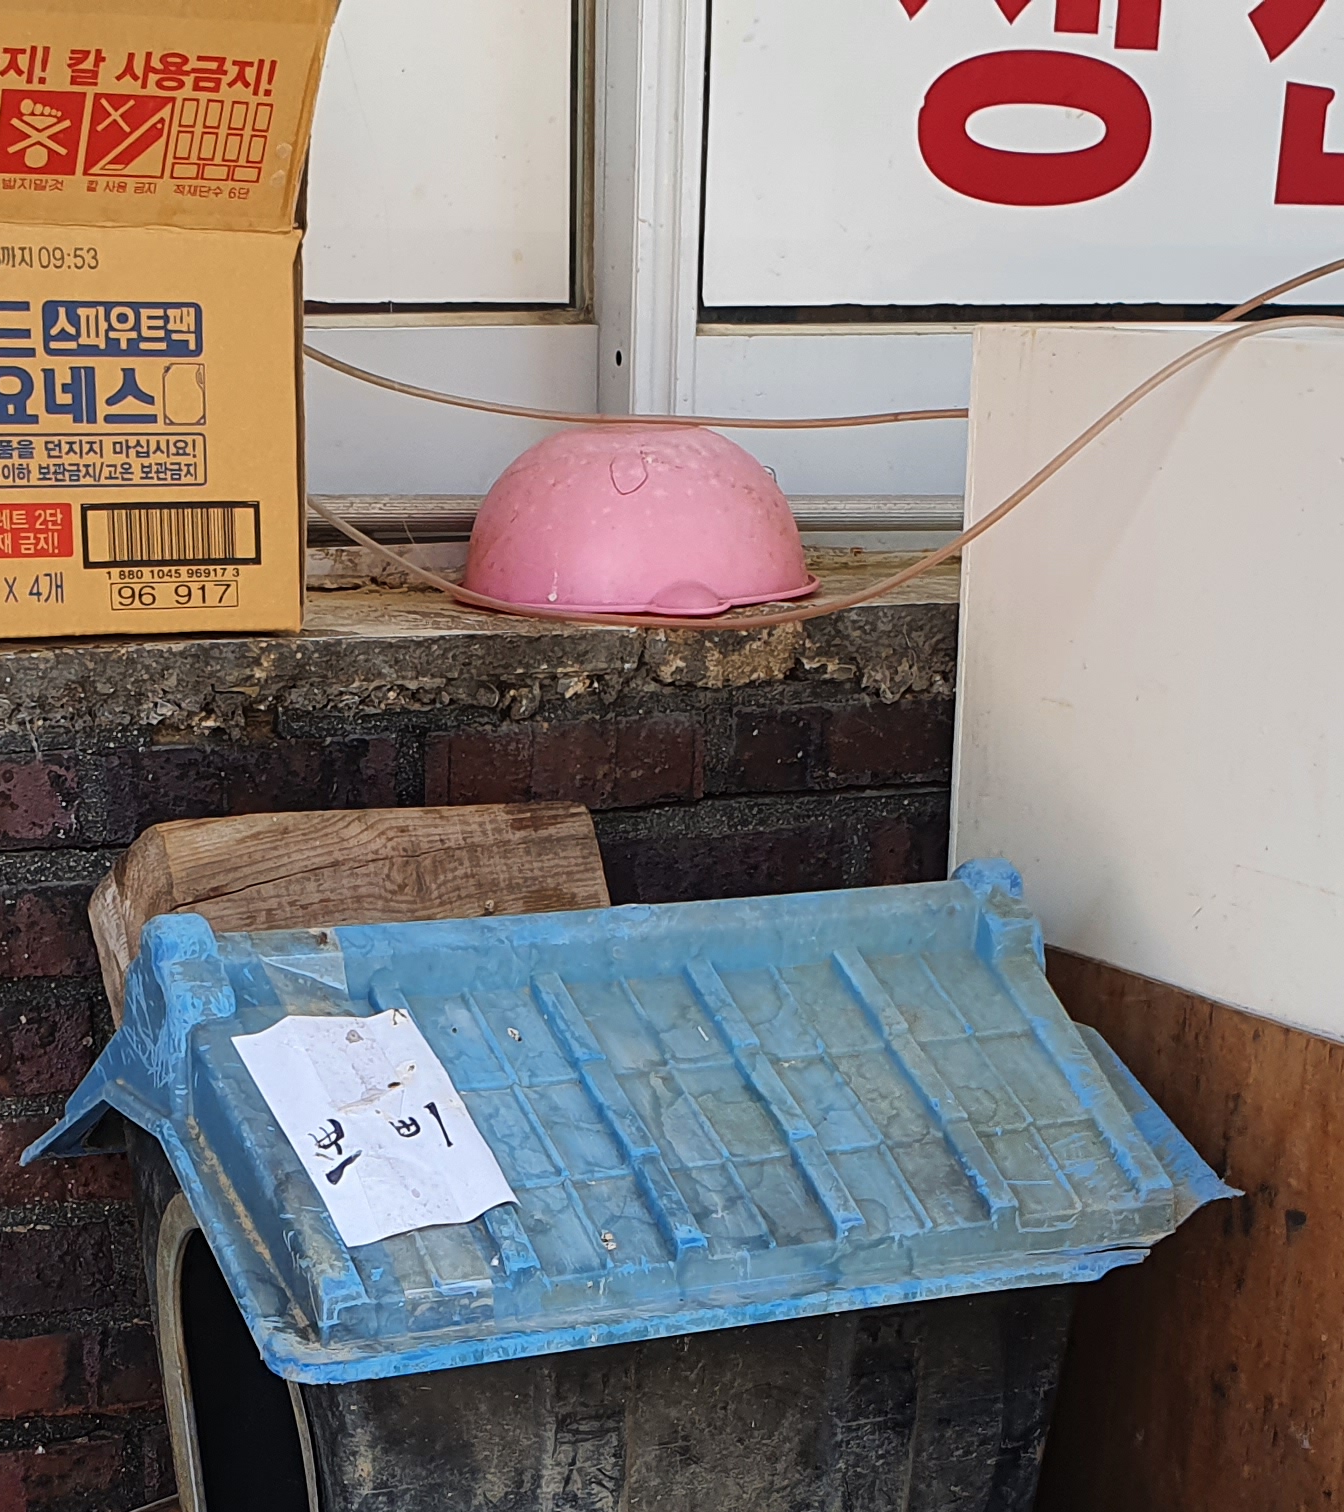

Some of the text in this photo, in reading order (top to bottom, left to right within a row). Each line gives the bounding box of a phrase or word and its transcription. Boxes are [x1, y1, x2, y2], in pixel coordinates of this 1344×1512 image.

[66, 48, 106, 87] 칼
[114, 50, 278, 98] 사용금지!
[86, 180, 157, 195] 칼 사용 금지
[37, 246, 99, 270] 09:53
[48, 305, 197, 351] 스파우트팩
[44, 439, 104, 459] 던지지
[112, 439, 197, 459] 마십시요!
[140, 461, 198, 482] 보관금지
[35, 508, 63, 530] 2단
[18, 532, 59, 554] 금지!
[118, 569, 144, 580] 880
[150, 568, 182, 579] 1045
[187, 567, 228, 578] 96917
[232, 567, 241, 578] 3
[28, 571, 65, 604] 4개
[117, 583, 232, 607] 96 917
